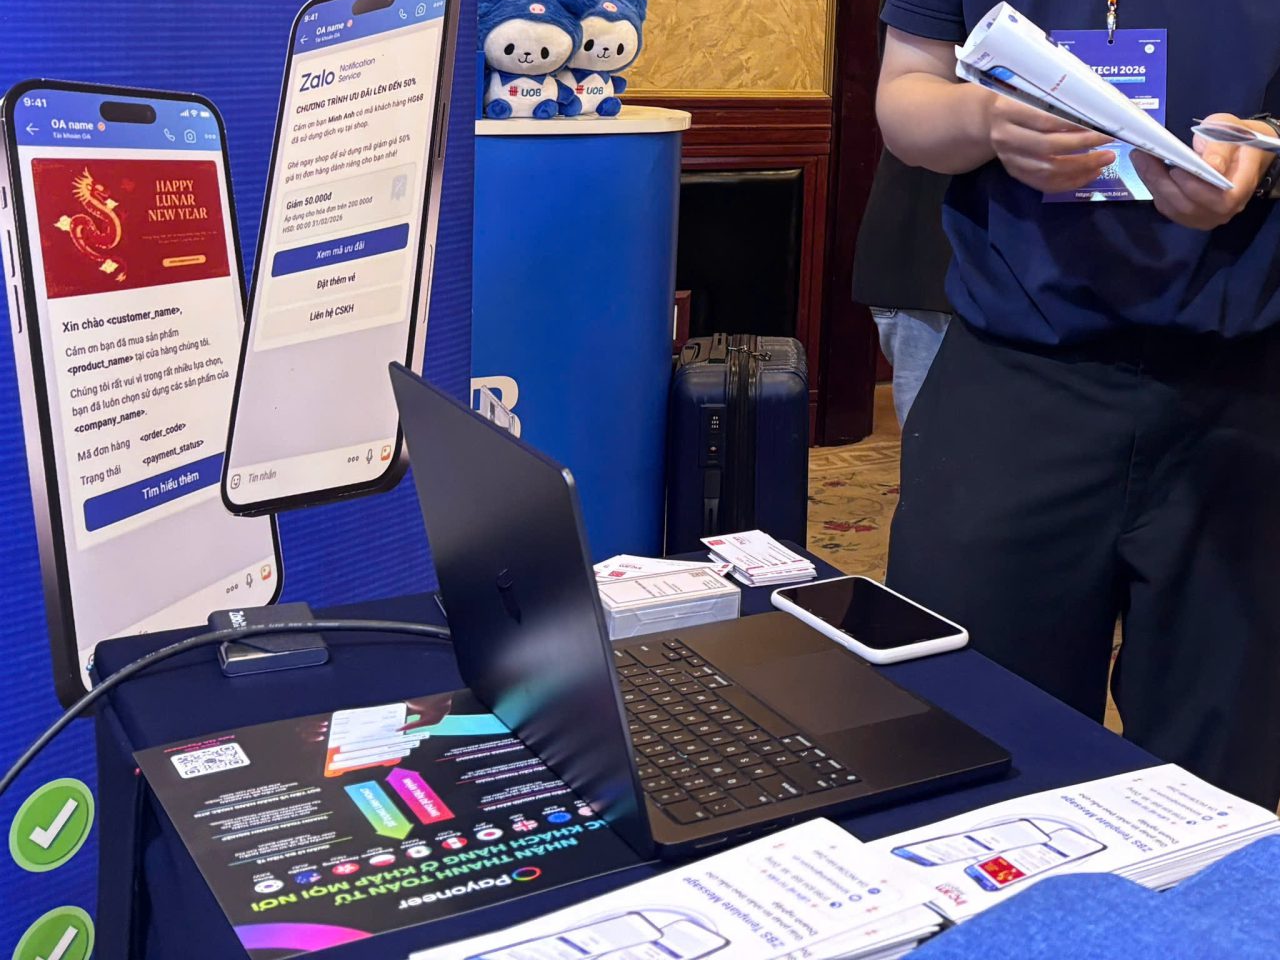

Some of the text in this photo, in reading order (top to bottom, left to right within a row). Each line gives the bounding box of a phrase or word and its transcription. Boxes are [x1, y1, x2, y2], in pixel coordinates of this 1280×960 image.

[304, 13, 318, 22] 9:41
[316, 22, 344, 35] OA name
[340, 58, 375, 72] Notification
[1120, 66, 1146, 74] 2026
[300, 69, 335, 92] Zalo
[338, 72, 361, 83] Service
[296, 100, 325, 114] CHƯƠNG
[328, 95, 348, 106] TRÌNH
[374, 85, 386, 95] LÊN
[403, 78, 416, 88] 50%
[521, 88, 542, 97] UOB
[586, 87, 604, 95] UOB
[23, 97, 47, 108] 9:41
[51, 119, 94, 130] OA name
[328, 114, 342, 123] Minh
[343, 111, 355, 120] Anh
[156, 180, 194, 192] HAPPY
[156, 194, 195, 207] LUNAR
[148, 207, 208, 221] NEW YEAR
[316, 250, 332, 259] Xem
[335, 304, 354, 316] CSKH
[63, 321, 79, 333] Xin
[82, 317, 104, 330] chào
[128, 335, 144, 345] mua
[68, 356, 133, 376] <product_name>
[161, 345, 177, 357] hàng
[70, 385, 98, 399] Chúng
[124, 376, 134, 387] vui
[144, 371, 162, 384] trong
[72, 405, 88, 417] bạn
[171, 382, 183, 392] các
[140, 423, 186, 442] <order_code>
[78, 450, 91, 462] Mã
[111, 439, 130, 454] hàng
[142, 440, 204, 466] <payment_status>
[80, 465, 122, 486] Trạng thái
[249, 473, 259, 483] Tin
[142, 487, 159, 500] Tìm
[509, 825, 584, 849] KHÁCH
[443, 844, 508, 865] HÀNG
[514, 837, 578, 860] NHẬN
[355, 866, 417, 887] KHẮP
[435, 854, 514, 881] THANH
[302, 881, 350, 899] MỌI
[368, 874, 434, 898] TOÁN
[399, 874, 513, 909] Payoneer
[683, 876, 722, 903] Message
[251, 893, 298, 912] NƠI
[722, 902, 764, 932] Template
